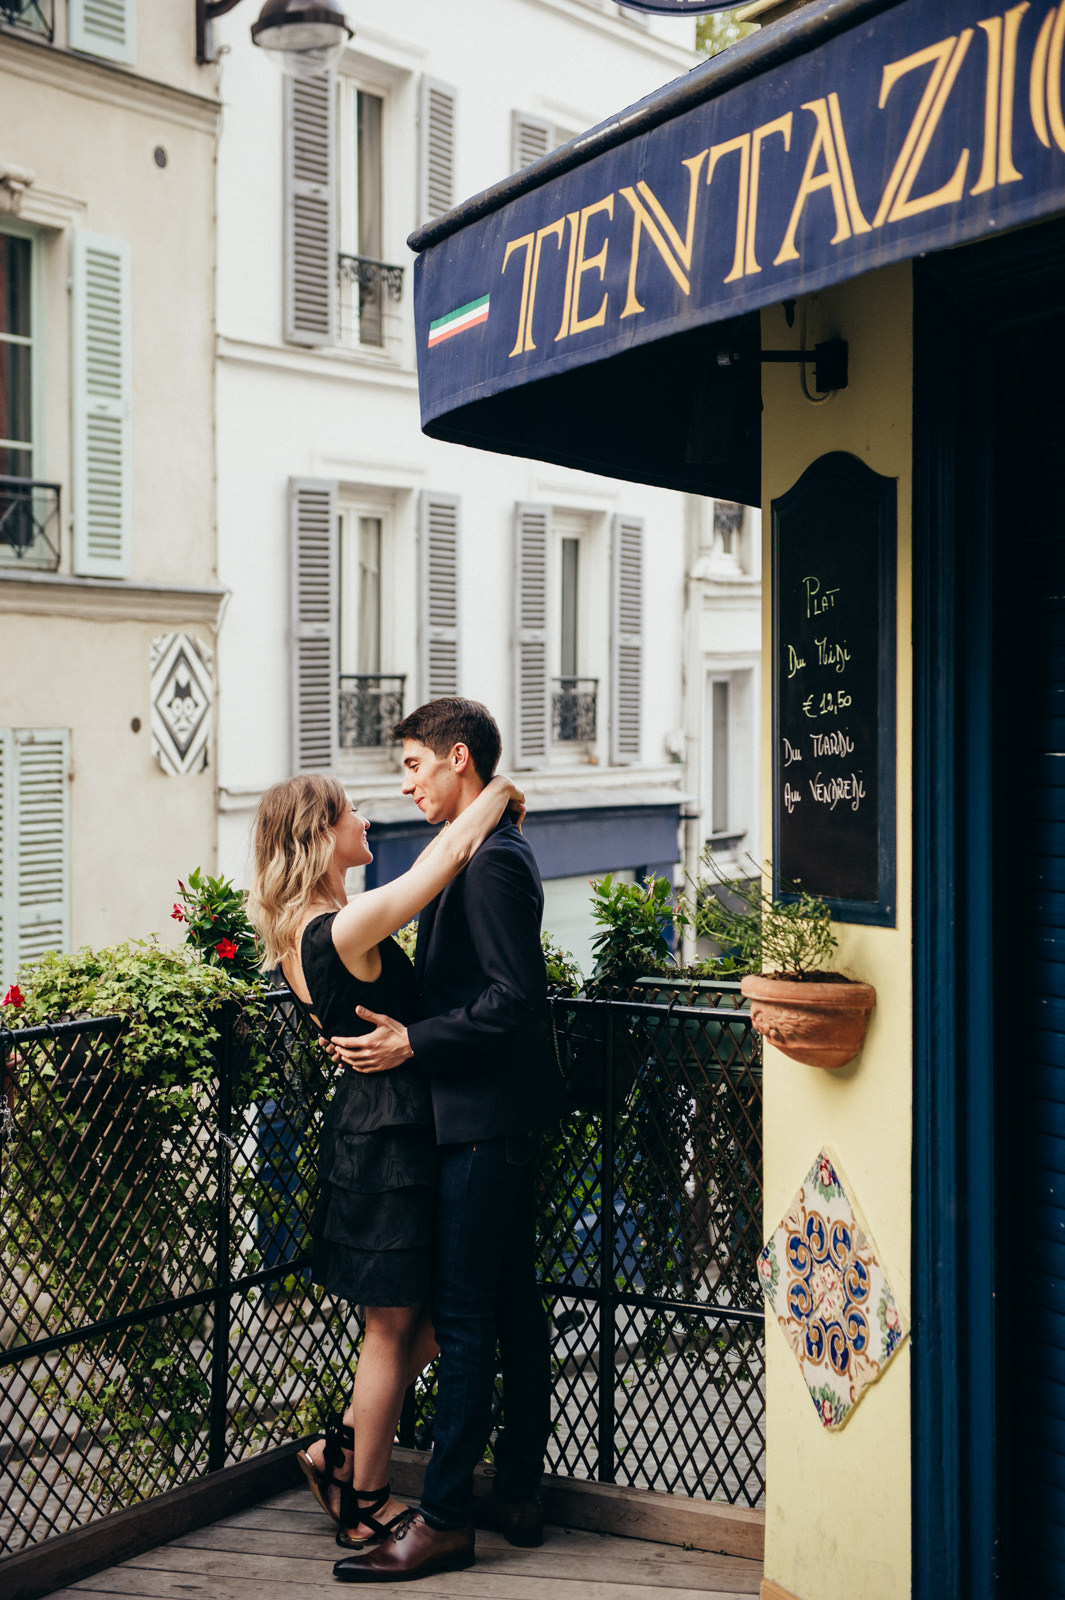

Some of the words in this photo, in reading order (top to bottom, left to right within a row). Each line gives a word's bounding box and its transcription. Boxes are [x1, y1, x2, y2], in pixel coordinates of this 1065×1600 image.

[787, 644, 806, 679] Du
[782, 737, 802, 767] Du
[784, 782, 802, 814] Au
